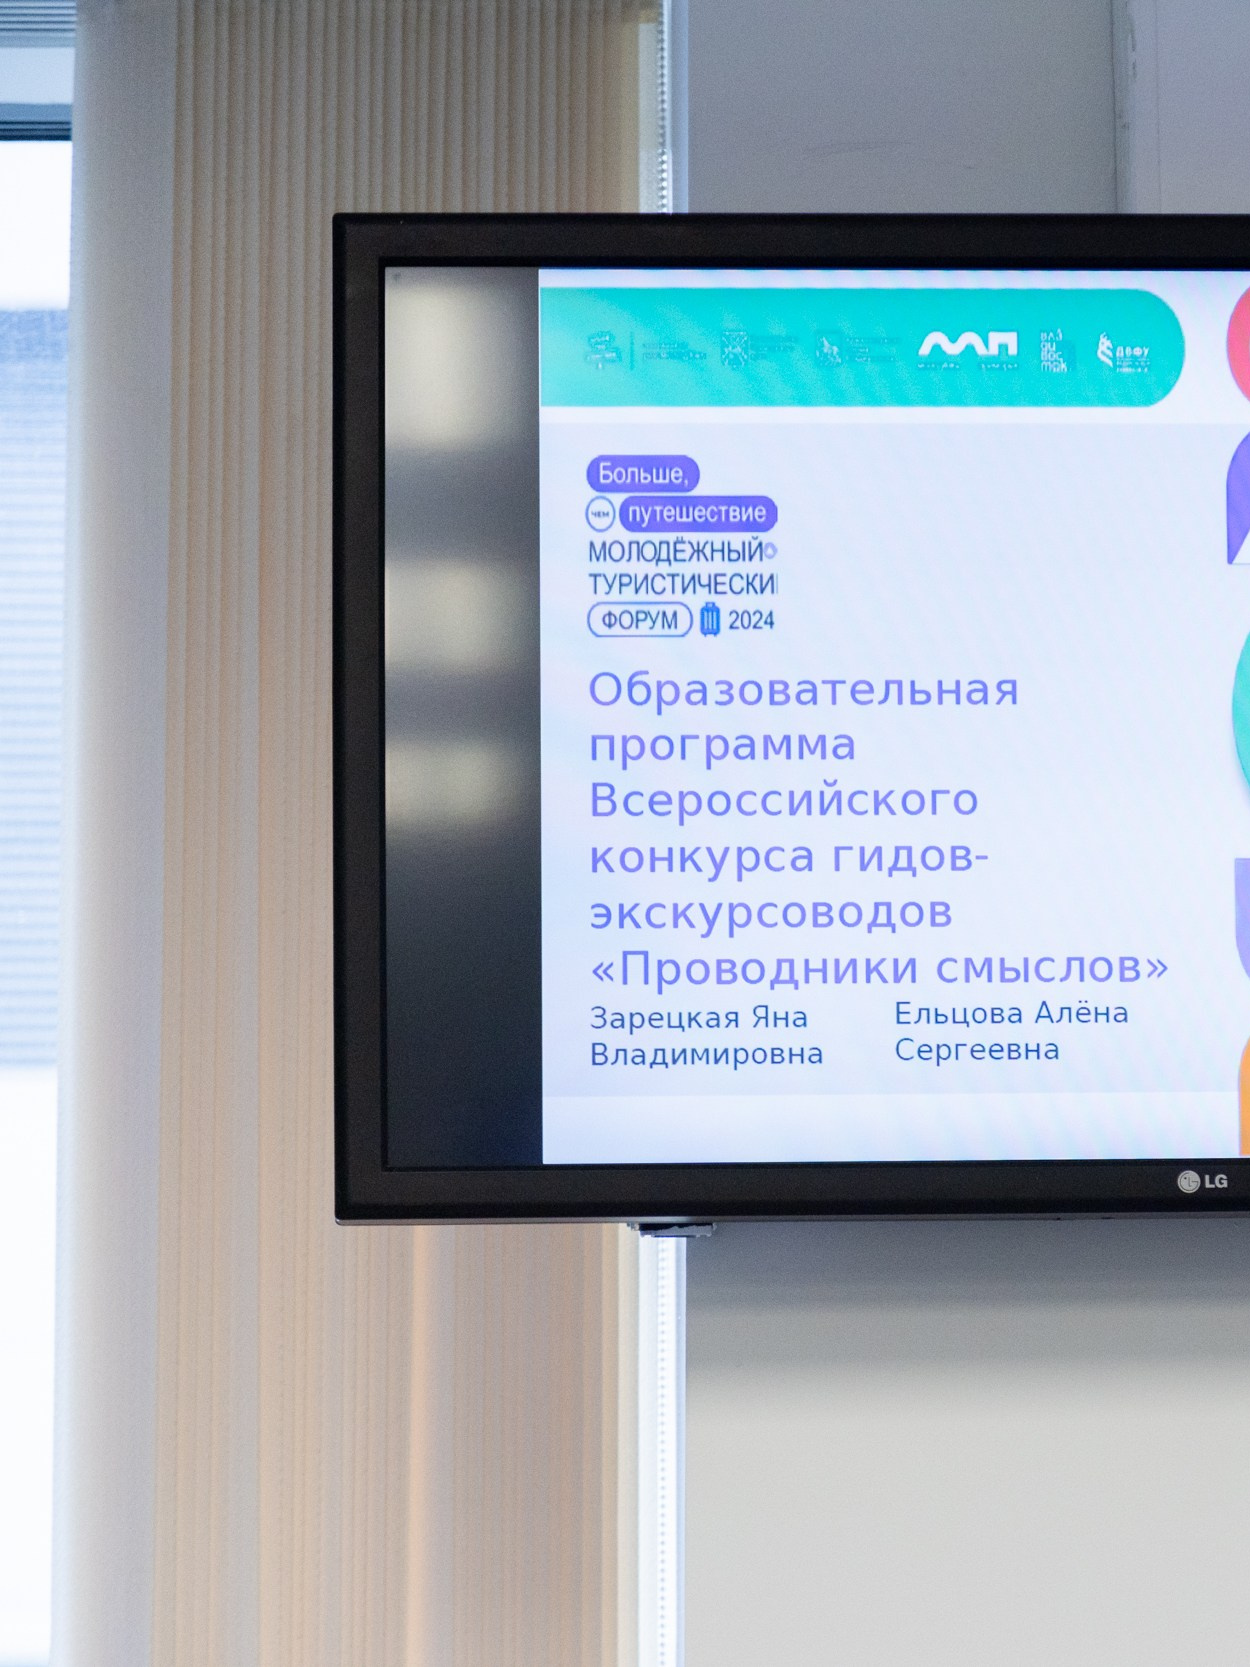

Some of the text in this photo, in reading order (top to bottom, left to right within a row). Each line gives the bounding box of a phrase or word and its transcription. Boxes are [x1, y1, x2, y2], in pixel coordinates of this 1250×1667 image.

[599, 461, 689, 487] Больше,
[629, 505, 766, 527] путешествие
[589, 535, 764, 566] МОЛОДЁЖНЫЙ
[588, 572, 778, 595] ТУРИСТИЧЕСКИ
[602, 610, 774, 629] ФОРУМ 2024
[590, 671, 1017, 716] Образовательная
[591, 735, 854, 771] программа
[592, 779, 977, 826] Всероссийского
[592, 846, 988, 882] конкурса гидов-
[591, 902, 951, 938] экскурсоводов
[592, 950, 1169, 995] «Проводники смыслов»
[591, 1005, 807, 1033] Зарецкая Яна
[896, 1001, 1127, 1027] Ельцова Алёна
[592, 1043, 822, 1070] Владимировна
[896, 1038, 1058, 1064] Сергеевна
[1205, 1174, 1227, 1188] LG
